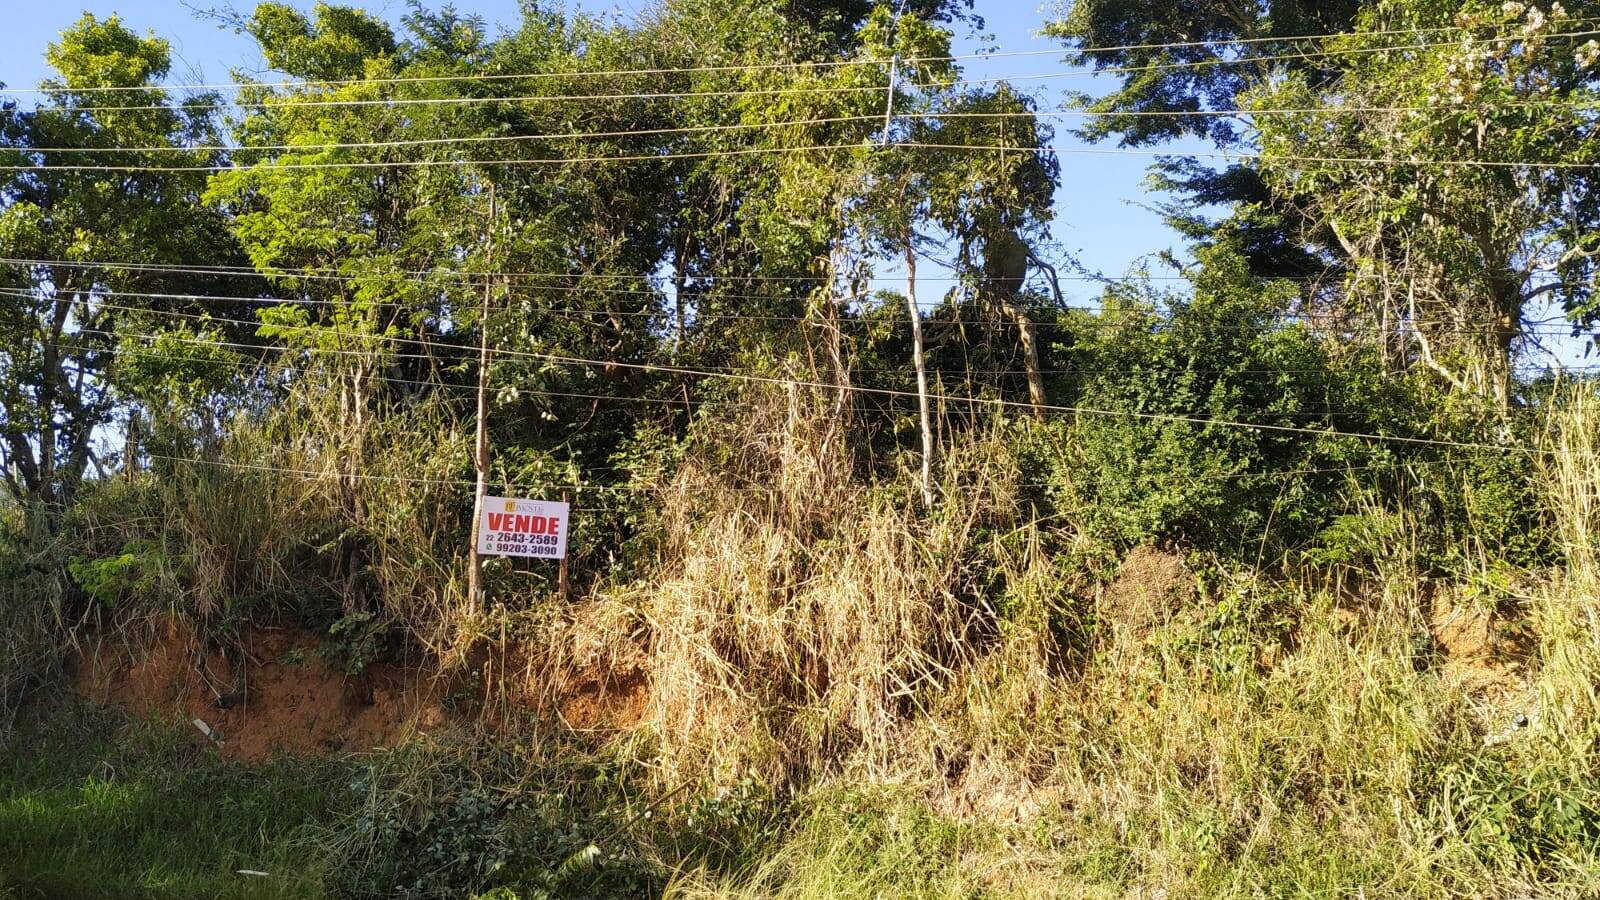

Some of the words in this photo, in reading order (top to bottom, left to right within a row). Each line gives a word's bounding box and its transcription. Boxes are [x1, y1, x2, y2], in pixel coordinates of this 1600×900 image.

[488, 513, 560, 535] VENDE
[497, 532, 558, 545] 2643-2589
[496, 543, 557, 555] 99203-3090
